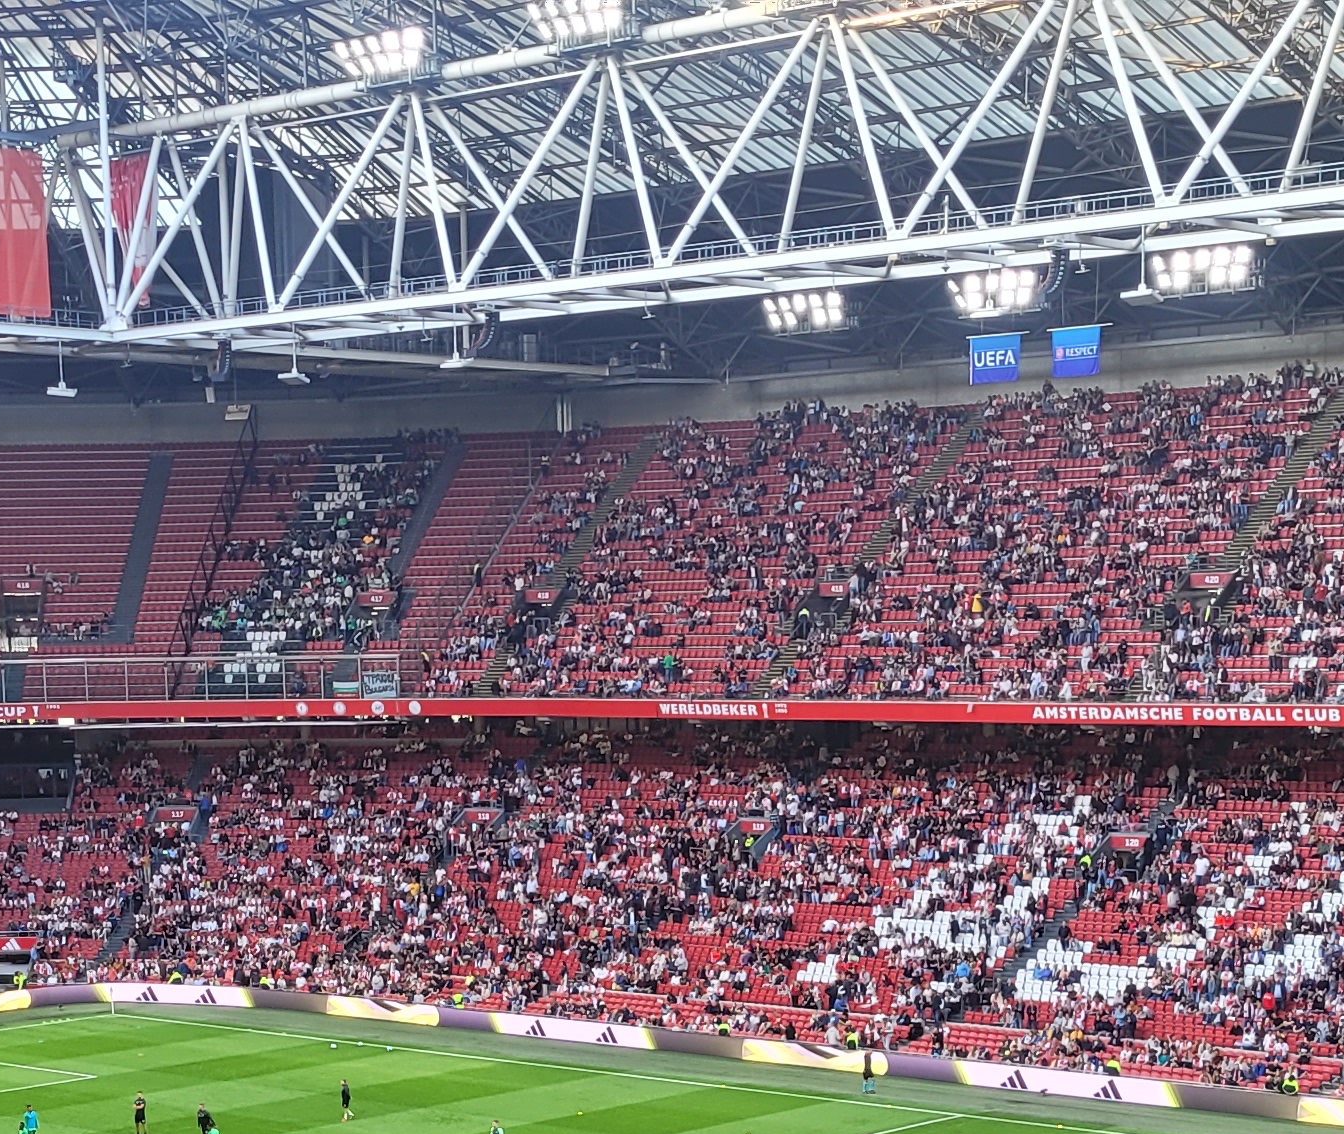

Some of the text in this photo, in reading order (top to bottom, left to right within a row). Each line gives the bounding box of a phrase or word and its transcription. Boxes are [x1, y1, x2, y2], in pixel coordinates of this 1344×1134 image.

[1065, 345, 1098, 358] RESPECT
[974, 349, 1016, 368] UEFA
[1204, 575, 1219, 584] 420
[370, 595, 384, 603] 417
[659, 703, 758, 716] WERELDBEKER
[1032, 706, 1183, 720] AMSTERDAMSCHE
[1192, 707, 1285, 722] FOOTBALL
[1291, 708, 1341, 722] CLUB
[1124, 838, 1139, 847] 120
